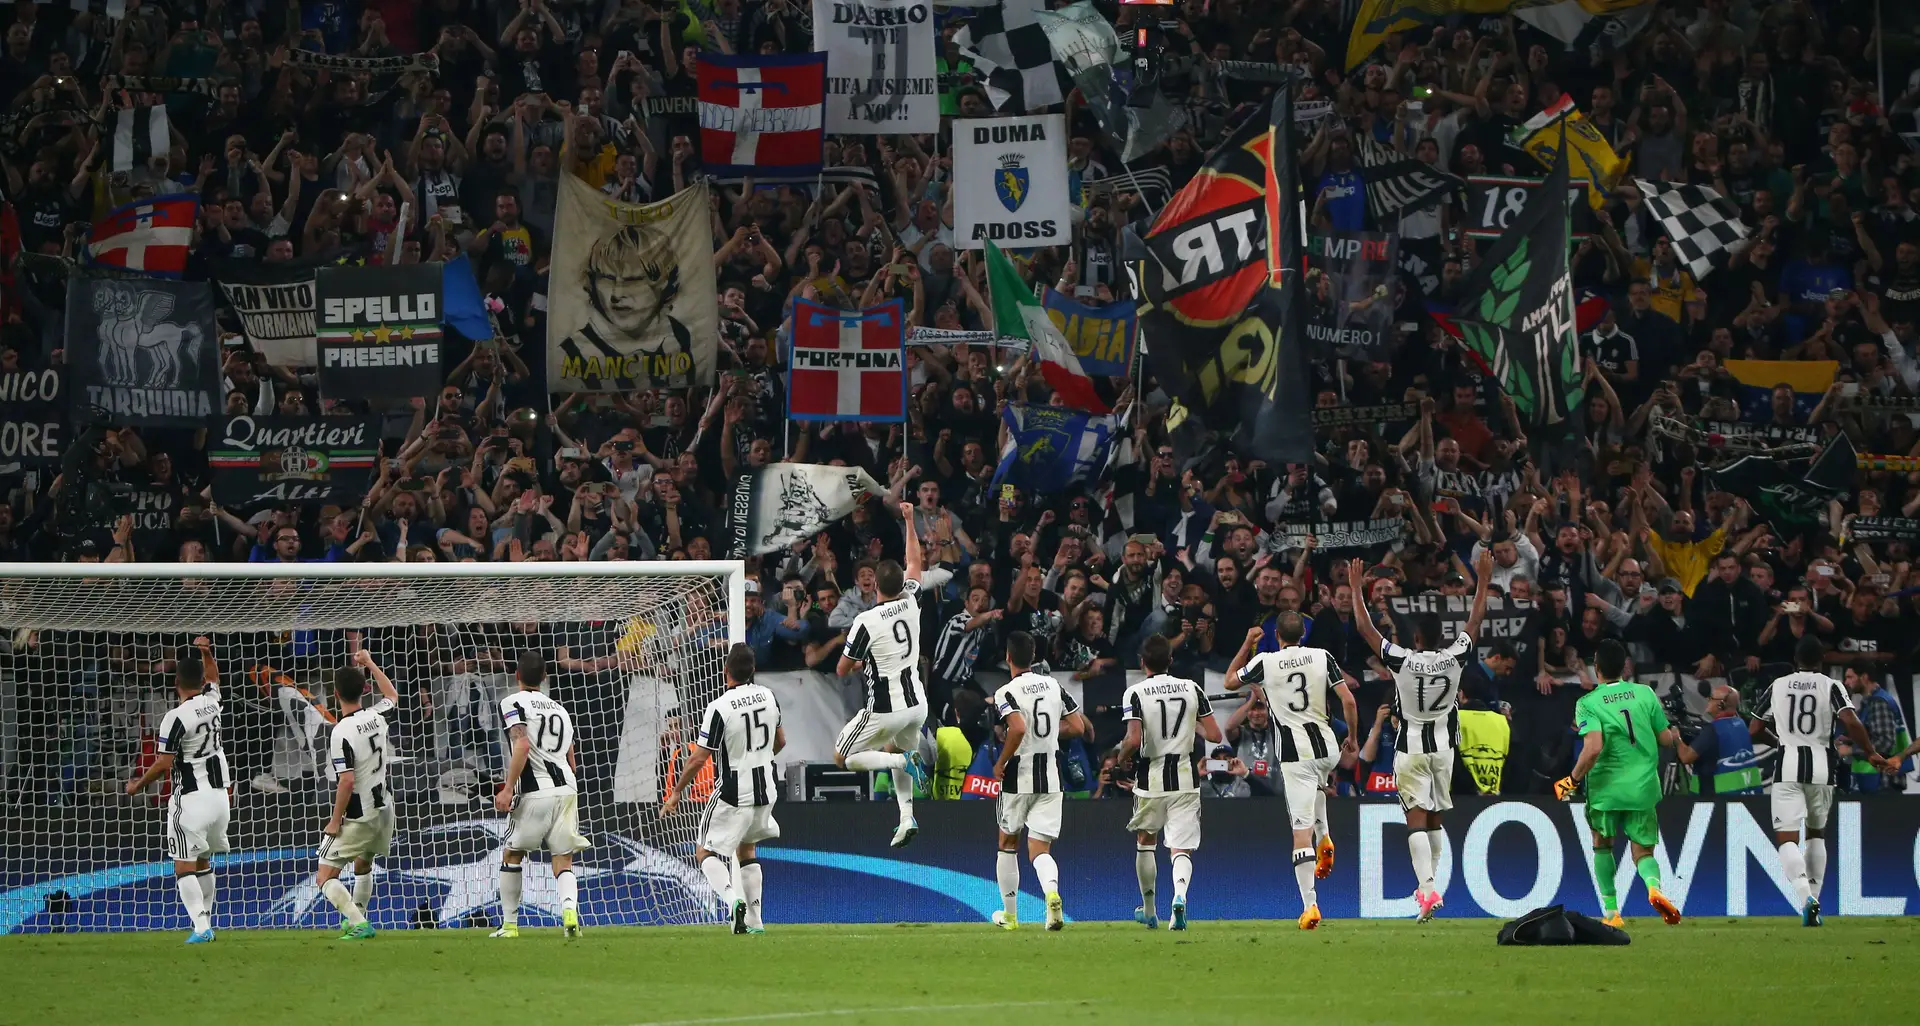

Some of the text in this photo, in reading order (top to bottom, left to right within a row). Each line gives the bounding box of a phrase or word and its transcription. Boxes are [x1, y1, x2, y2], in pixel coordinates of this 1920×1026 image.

[833, 3, 928, 26] DARIO
[861, 28, 899, 45] VIVE
[876, 53, 886, 70] E
[827, 77, 934, 95] TIFA INSIEME
[848, 103, 858, 120] A
[864, 103, 893, 120] NOI
[974, 122, 1046, 145] DUMA
[427, 183, 452, 196] Jeep
[36, 213, 58, 226] Jeep
[971, 220, 1057, 240] ADOSS
[264, 284, 312, 308] VITO
[324, 293, 436, 323] SPELLO
[1306, 323, 1382, 345] NUMERO 1
[324, 344, 439, 367] PRESENTE
[561, 353, 691, 380] MANCINO
[795, 349, 900, 369] TORTONA
[87, 385, 213, 417] TARQUINIA
[223, 415, 366, 451] Quartieri
[245, 482, 333, 504] Alti
[880, 602, 909, 619] HIGUAIN
[1391, 597, 1437, 614] CHi
[893, 620, 912, 660] 9
[1278, 656, 1314, 670] CHIELLINI
[1406, 657, 1457, 675] ALEX SANDRO
[1021, 681, 1051, 696] KHEDIRA
[1286, 673, 1310, 713] 3
[1415, 675, 1452, 713] 12
[1788, 680, 1818, 691] LEMINA
[530, 700, 561, 711] BONUCC
[730, 696, 768, 710] BARZAGLI
[1602, 690, 1637, 705] BUFFON
[1033, 697, 1052, 739] 6
[1156, 697, 1188, 739] 17
[1787, 694, 1817, 735] 18
[740, 708, 769, 752] 15
[1620, 709, 1636, 745] 1
[368, 733, 384, 773] 5
[1360, 801, 1920, 918] DOWNL
